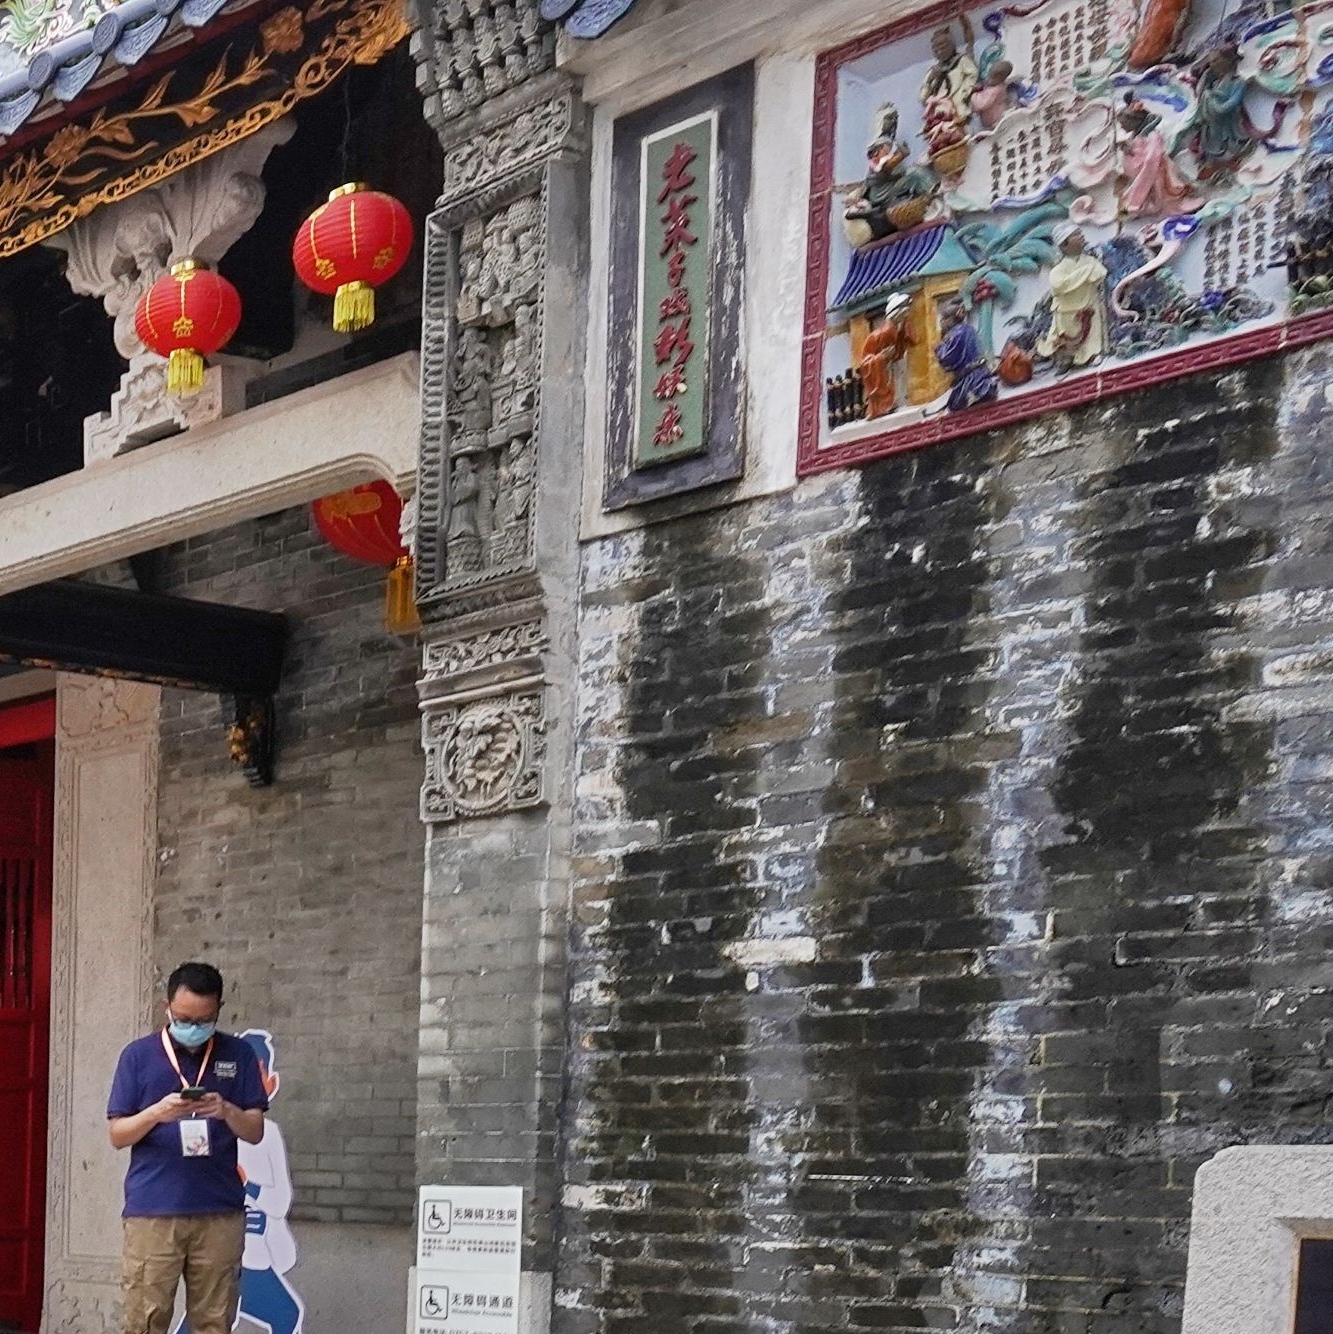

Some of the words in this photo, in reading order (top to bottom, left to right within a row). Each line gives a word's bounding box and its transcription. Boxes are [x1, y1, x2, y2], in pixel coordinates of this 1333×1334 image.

[453, 1207, 517, 1221] 无障碍卫生间
[451, 1293, 513, 1309] 无障碍通道
